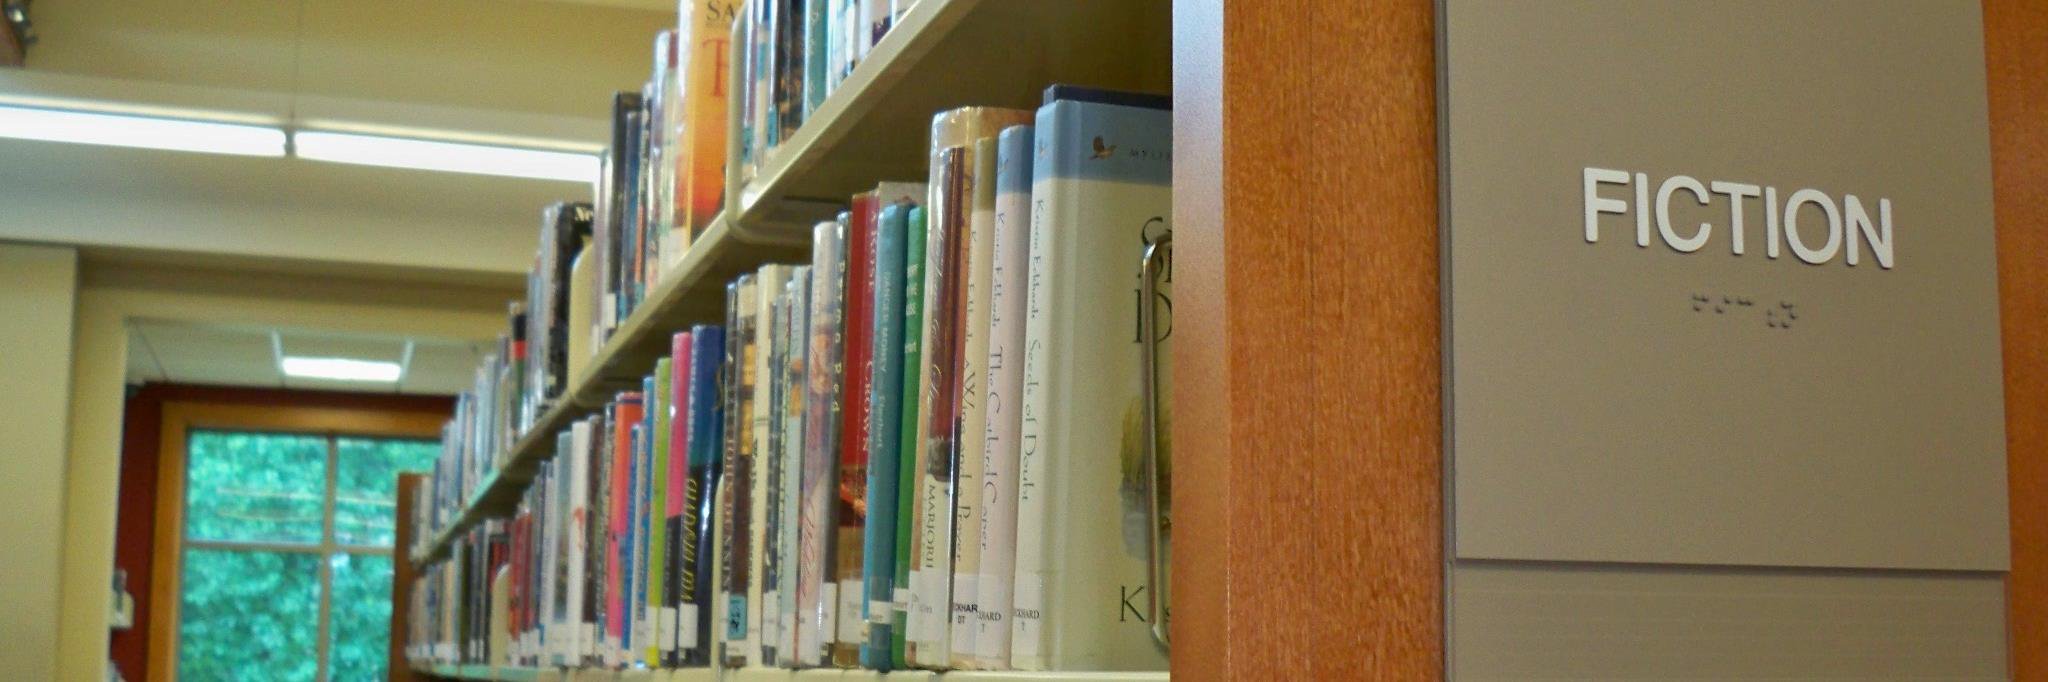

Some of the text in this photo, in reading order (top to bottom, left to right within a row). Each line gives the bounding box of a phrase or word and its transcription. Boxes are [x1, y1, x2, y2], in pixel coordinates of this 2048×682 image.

[1583, 166, 1895, 270] FICTION
[989, 345, 1003, 386] The
[1026, 339, 1041, 395] Seeds
[1024, 404, 1038, 424] of
[1021, 434, 1037, 501] Doubt
